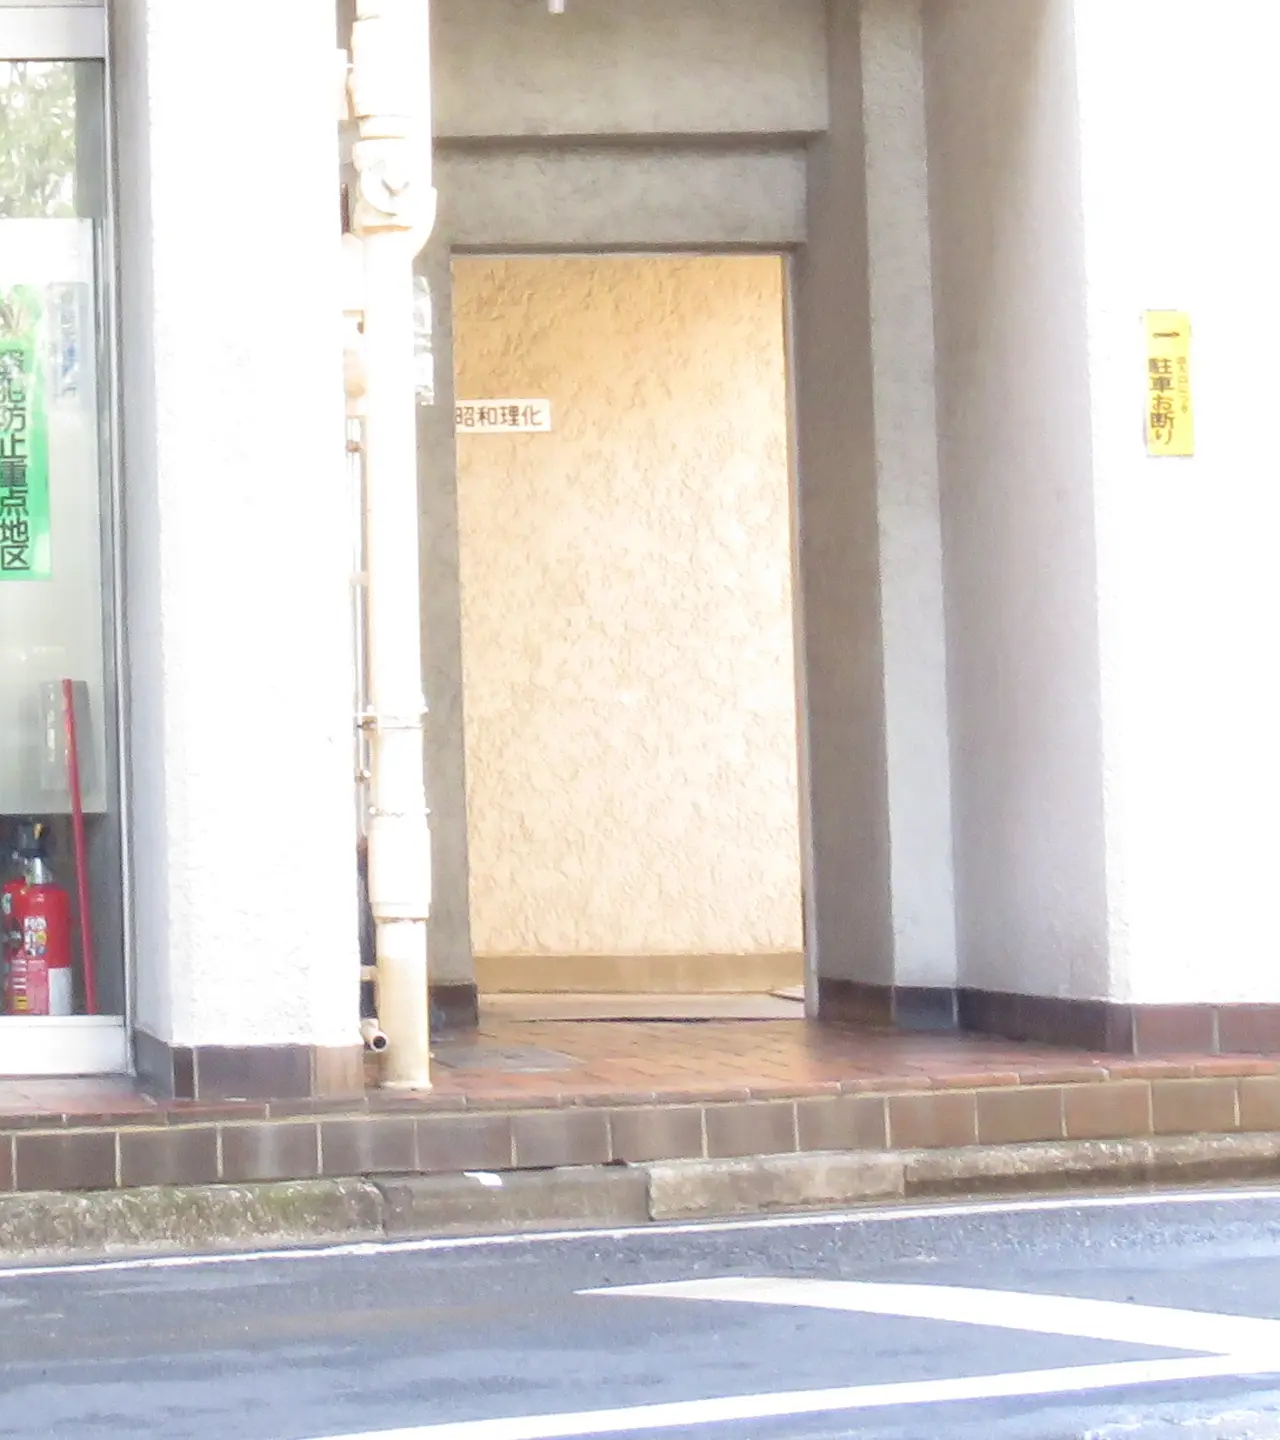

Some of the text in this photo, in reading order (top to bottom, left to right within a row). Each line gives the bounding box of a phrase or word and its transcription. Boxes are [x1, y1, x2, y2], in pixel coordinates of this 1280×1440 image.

[1148, 356, 1175, 446] 駐車お断り
